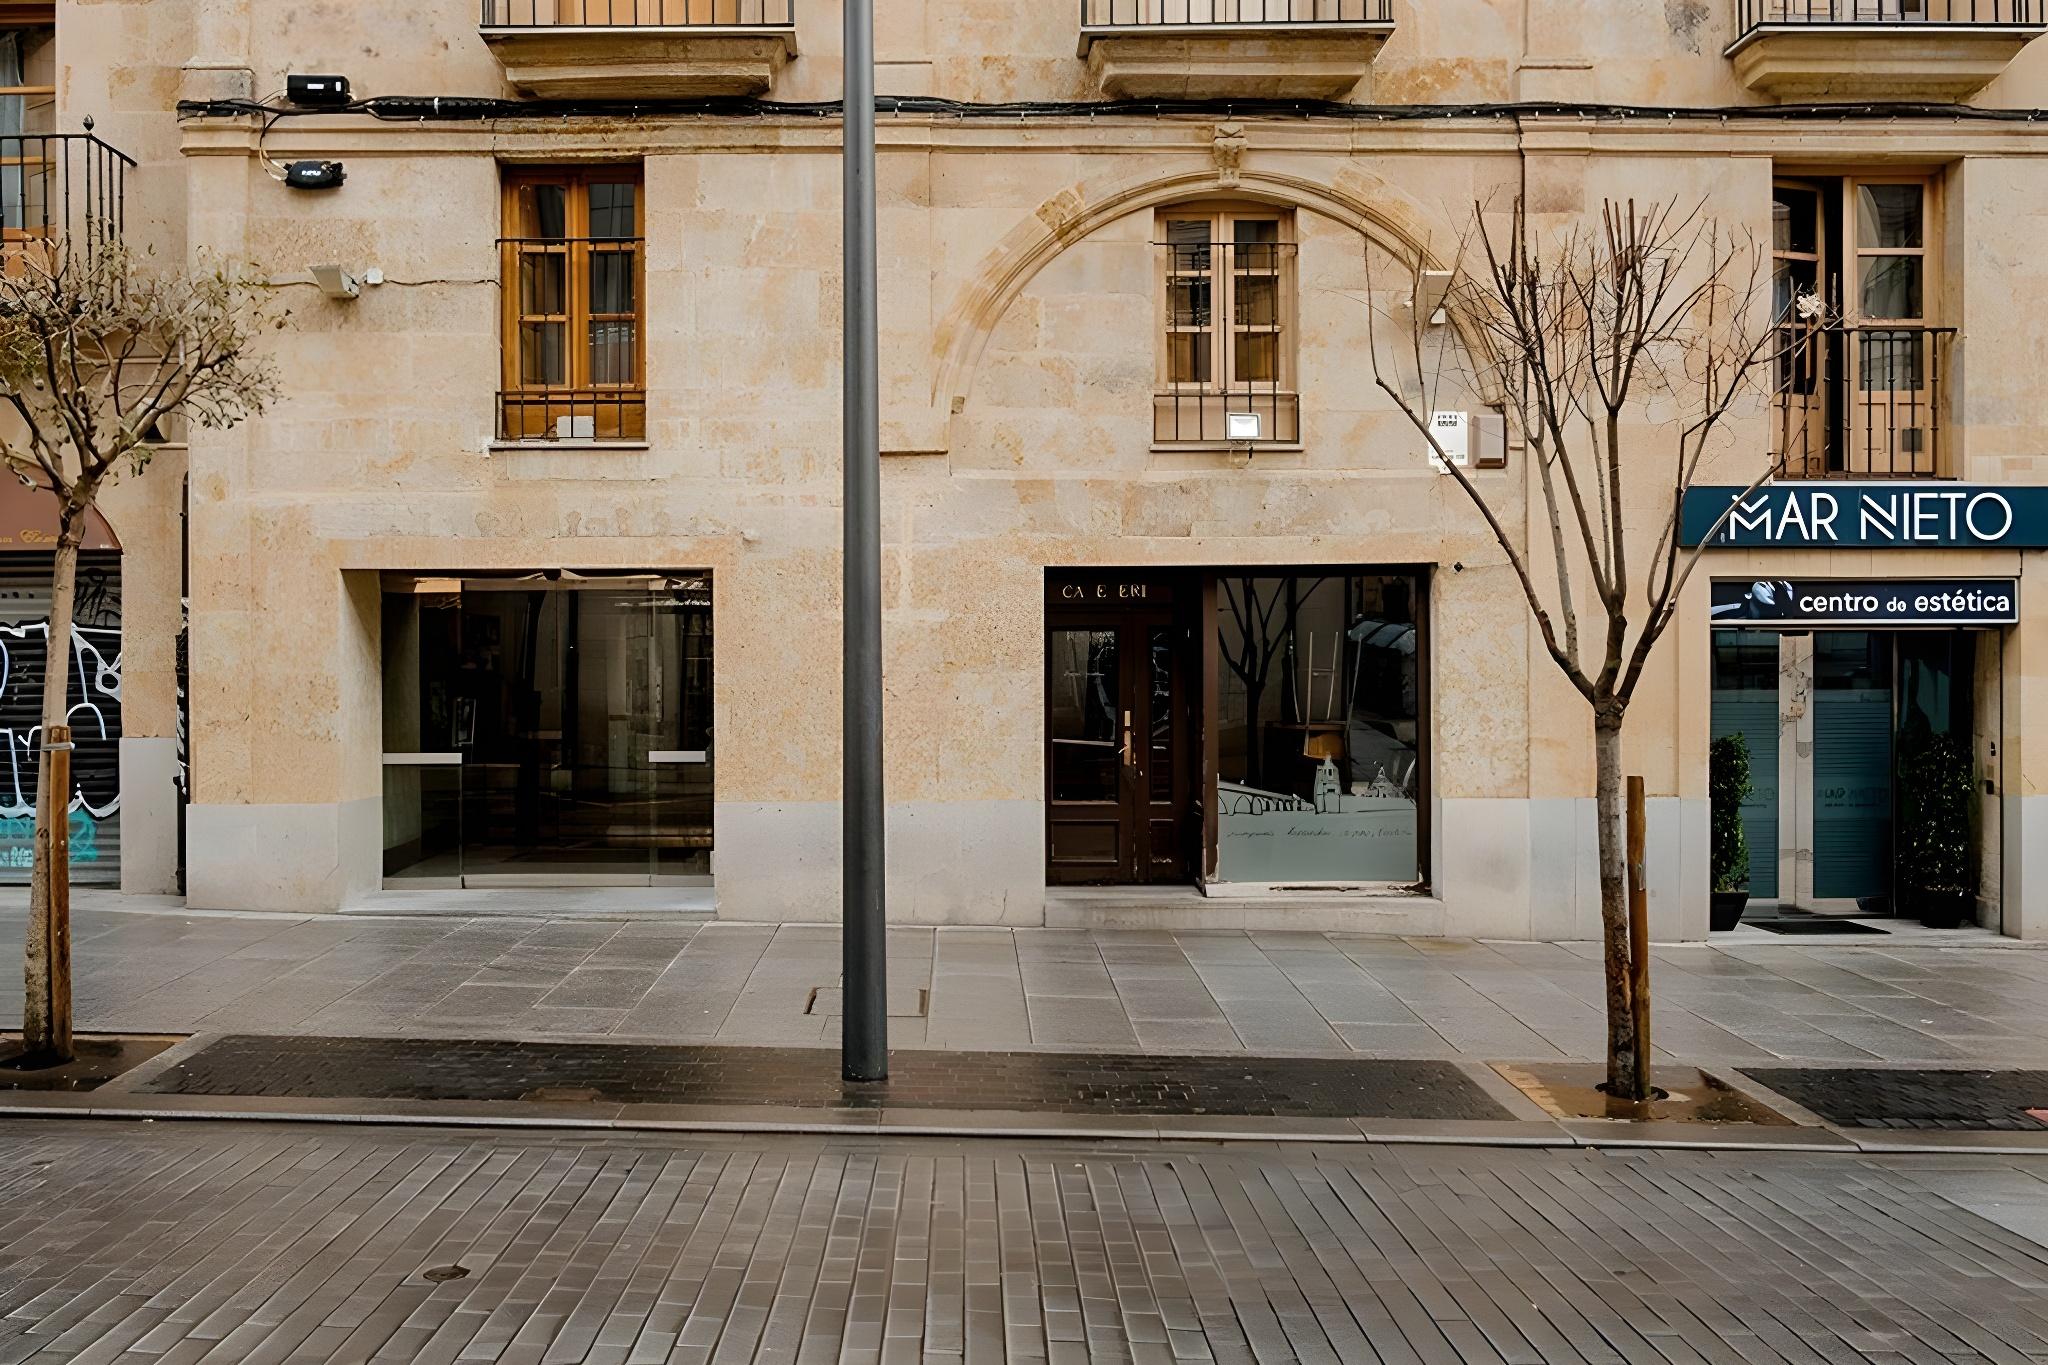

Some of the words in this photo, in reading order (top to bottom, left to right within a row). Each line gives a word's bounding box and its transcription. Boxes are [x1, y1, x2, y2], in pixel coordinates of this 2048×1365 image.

[1730, 491, 1839, 540] MAR
[1861, 492, 2012, 541] NIETO
[1800, 593, 1879, 612] centro
[1915, 589, 2010, 612] estética
